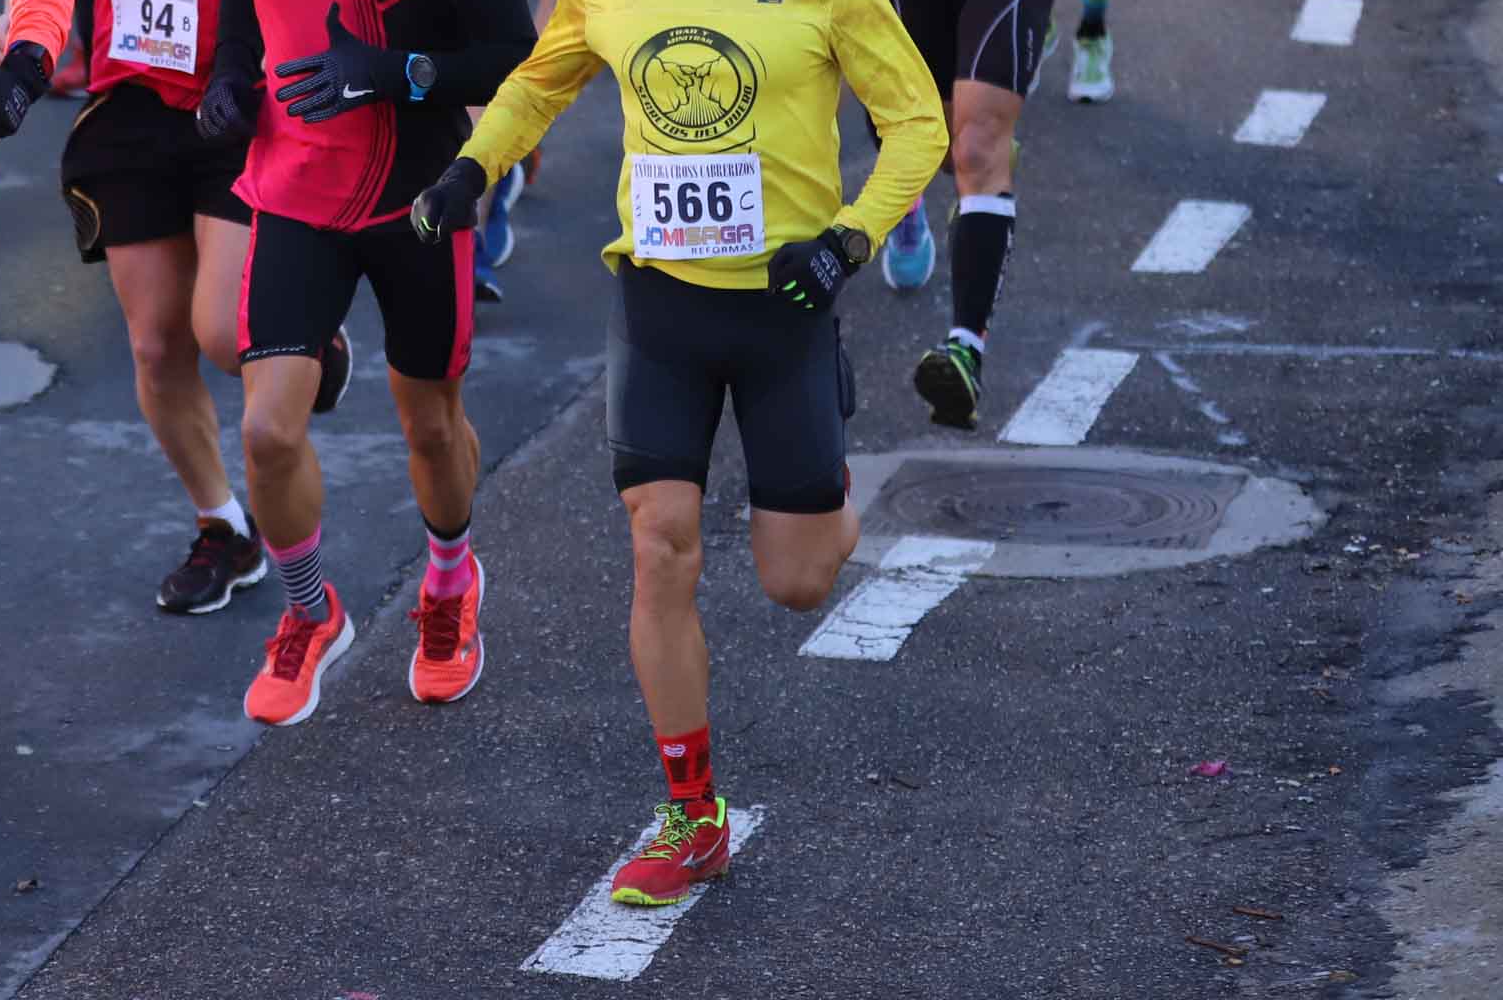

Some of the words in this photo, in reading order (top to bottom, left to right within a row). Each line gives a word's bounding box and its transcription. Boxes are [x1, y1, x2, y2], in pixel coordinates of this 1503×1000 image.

[141, 0, 174, 38] 94
[671, 163, 698, 179] CROSS
[700, 161, 755, 178] CABRERIZOS
[654, 181, 733, 224] 566
[740, 190, 755, 210] C
[640, 224, 755, 247] JOMISAGA
[691, 244, 754, 255] REFORMAS
